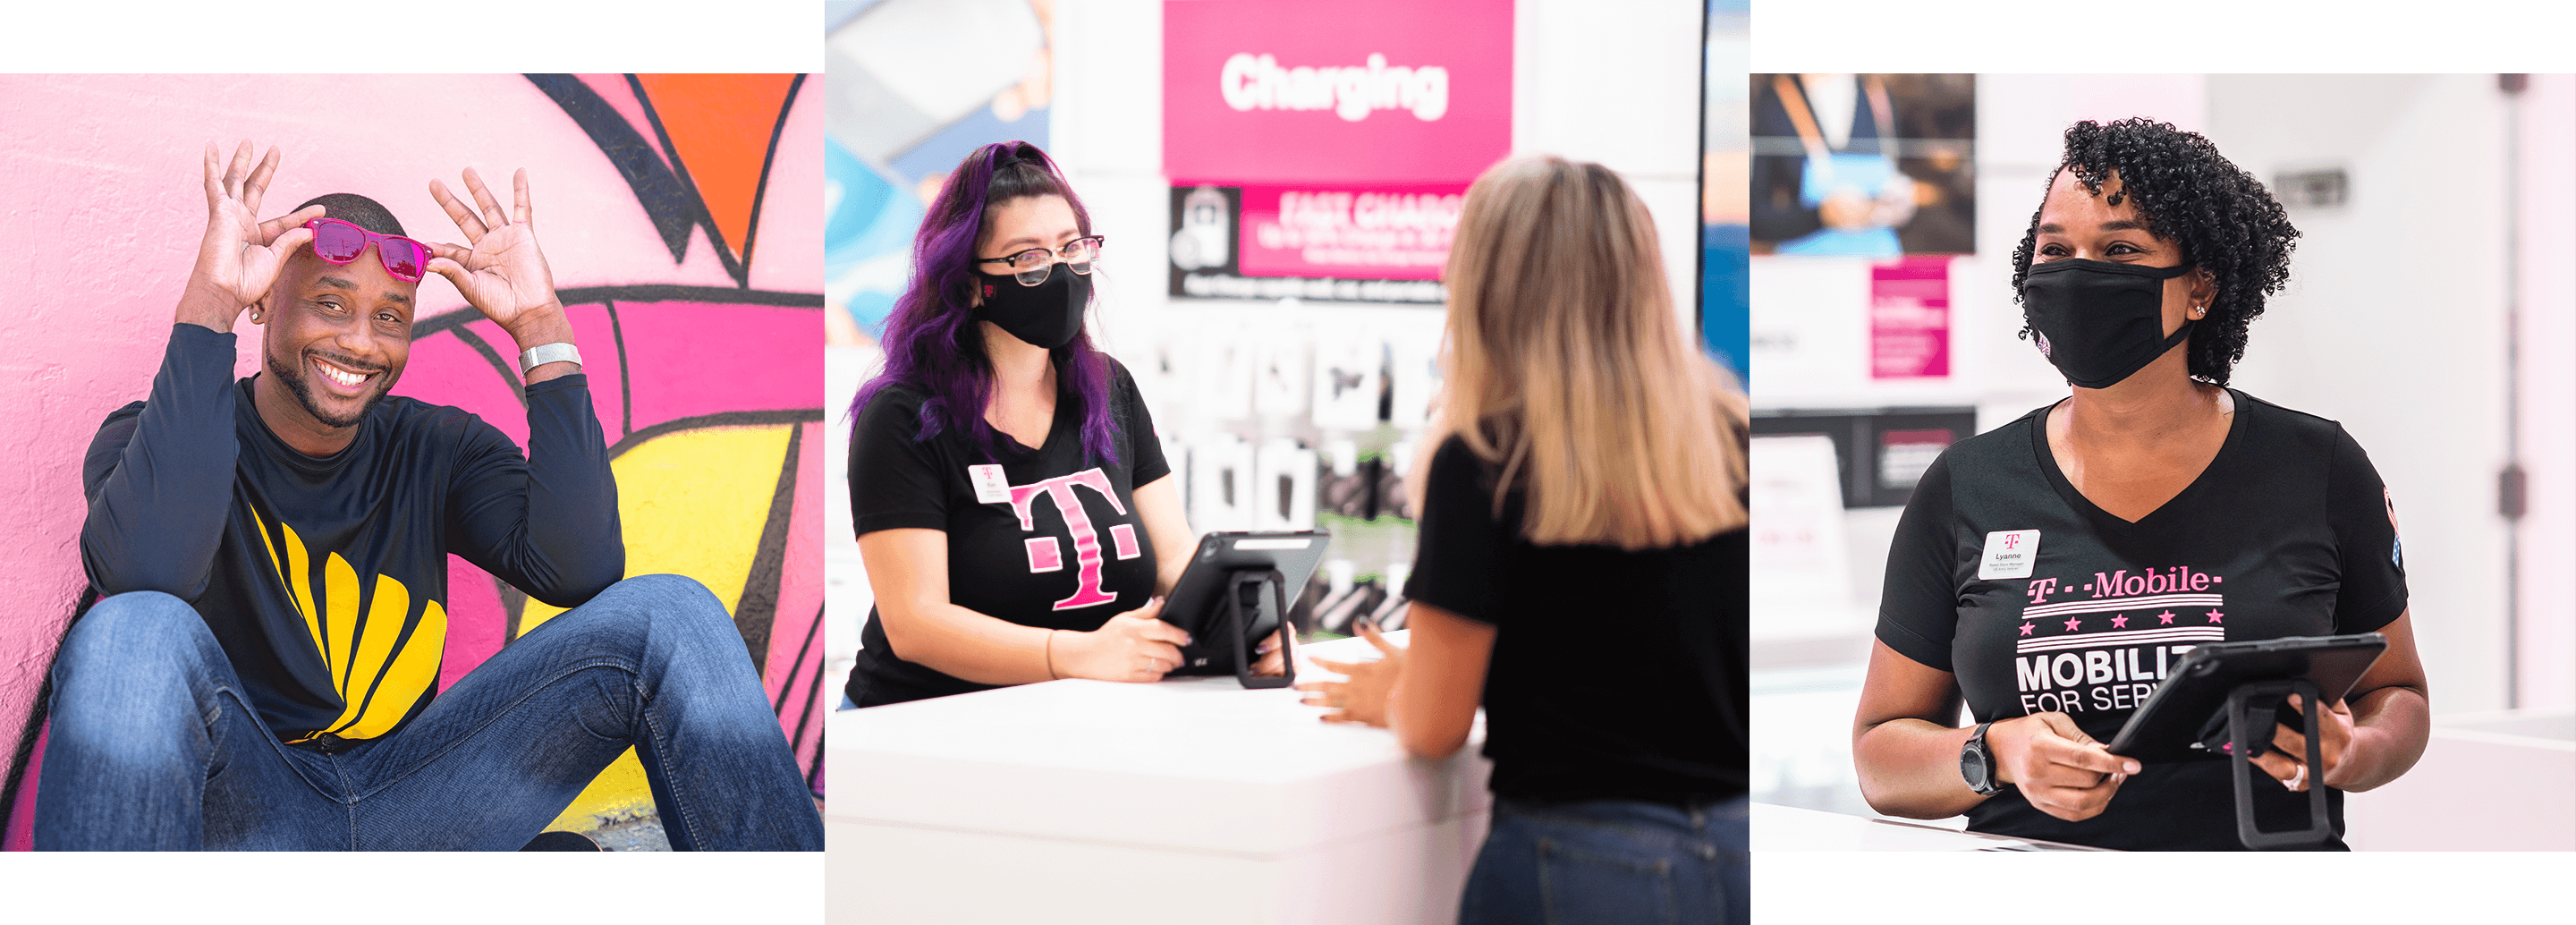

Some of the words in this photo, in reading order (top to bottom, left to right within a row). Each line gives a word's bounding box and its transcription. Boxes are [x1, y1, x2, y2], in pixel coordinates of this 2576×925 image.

[1220, 52, 1449, 122] Charging
[1279, 192, 1351, 226] FAST
[1354, 193, 1464, 229] CHARG
[1996, 553, 2021, 561] Lyanne
[2020, 689, 2084, 717] FOR
[2091, 682, 2161, 711] SER
